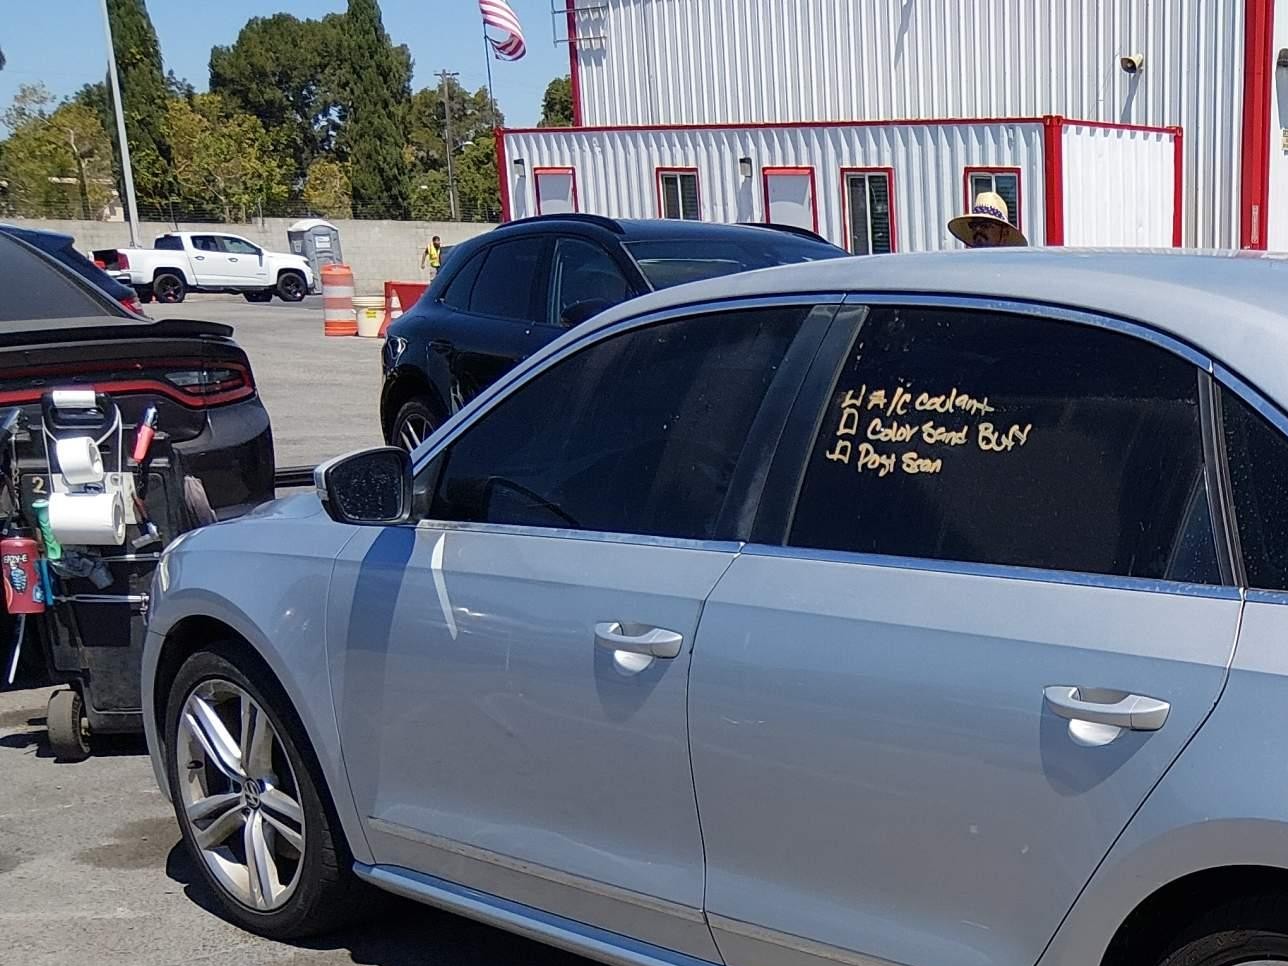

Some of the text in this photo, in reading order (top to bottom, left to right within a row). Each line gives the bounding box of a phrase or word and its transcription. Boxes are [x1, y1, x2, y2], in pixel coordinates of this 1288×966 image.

[867, 417, 918, 443] Color
[921, 420, 968, 446] Sand
[858, 442, 942, 477] Post Scan
[32, 475, 47, 494] 2
